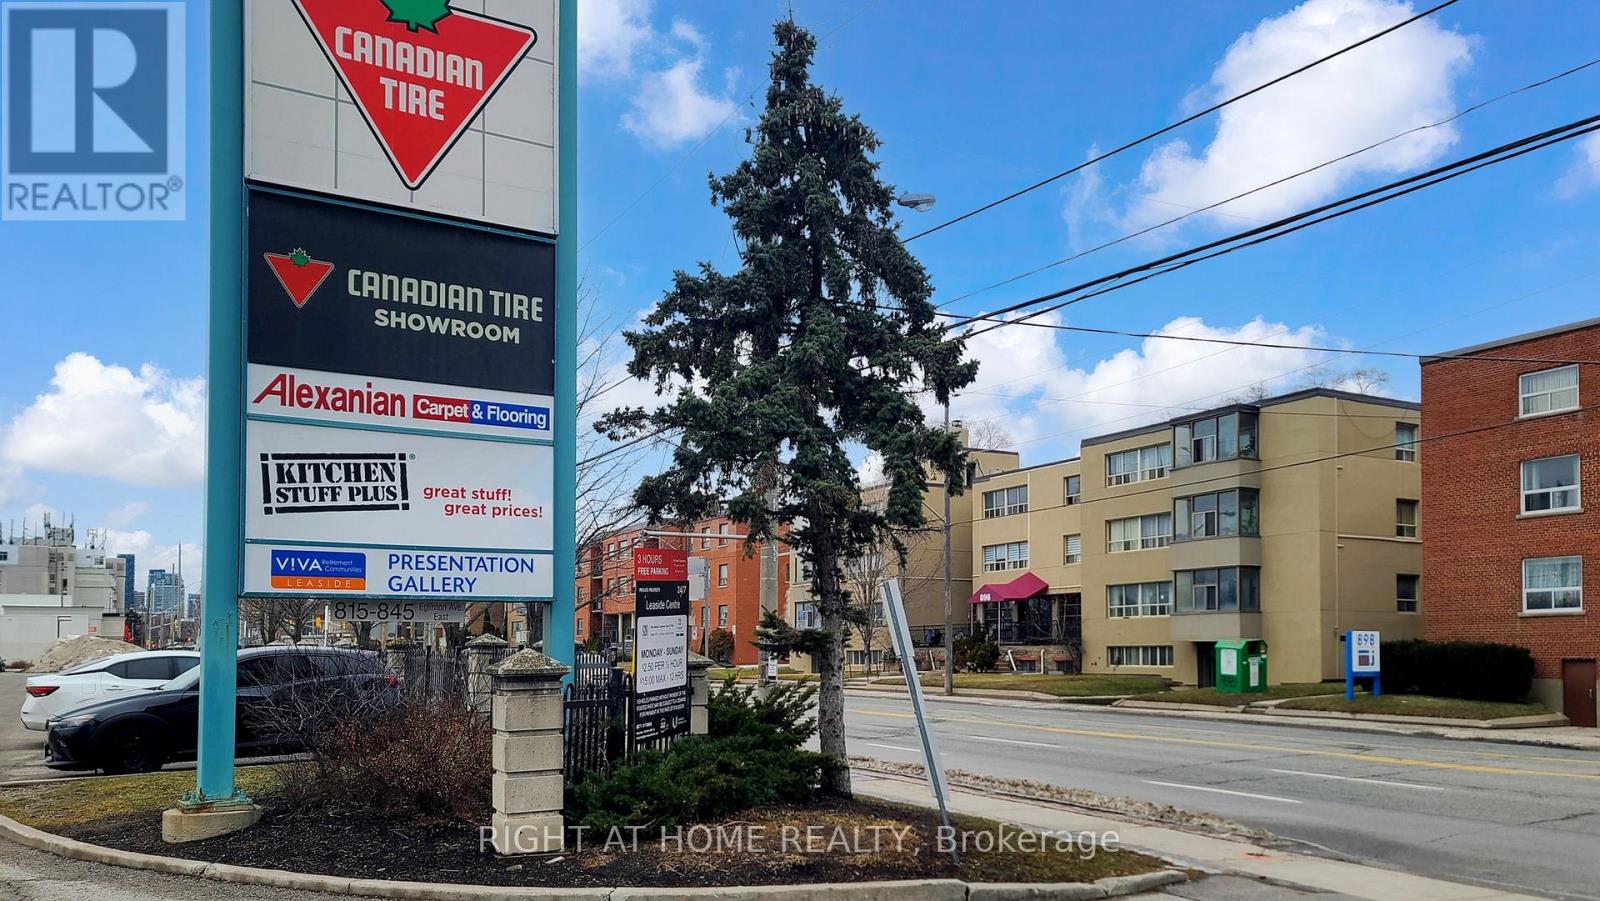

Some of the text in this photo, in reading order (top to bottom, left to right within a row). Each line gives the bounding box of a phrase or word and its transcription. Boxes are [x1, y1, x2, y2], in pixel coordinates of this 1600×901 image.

[335, 26, 483, 91] CANADIAN
[379, 76, 445, 121] TIRE
[348, 269, 543, 322] CANADIAN TIRE
[374, 308, 520, 344] SHOWROOM
[253, 373, 406, 418] Alexanian
[416, 398, 548, 429] Carpet & Flooring
[275, 462, 396, 484] KITCHEN
[275, 485, 398, 503] STUFF PLUS
[423, 486, 512, 502] great stuff!
[444, 502, 543, 519] great prices!
[388, 554, 535, 574] PRESENTATION
[637, 554, 642, 565] 3
[642, 554, 663, 565] HOURS
[324, 565, 362, 573] Communities
[638, 567, 650, 576] FREE
[650, 567, 669, 576] PARKING
[287, 578, 352, 588] LEASIDE
[388, 575, 478, 594] GALLERY
[334, 601, 415, 621] 815-845
[645, 599, 681, 610] Leaside Centre
[433, 612, 449, 621] East
[1357, 633, 1375, 646] 898
[641, 648, 663, 658] MONDAY
[666, 646, 684, 656] SUNDAY
[655, 660, 665, 670] PER
[670, 658, 683, 668] HOUR
[655, 674, 667, 683] MAX
